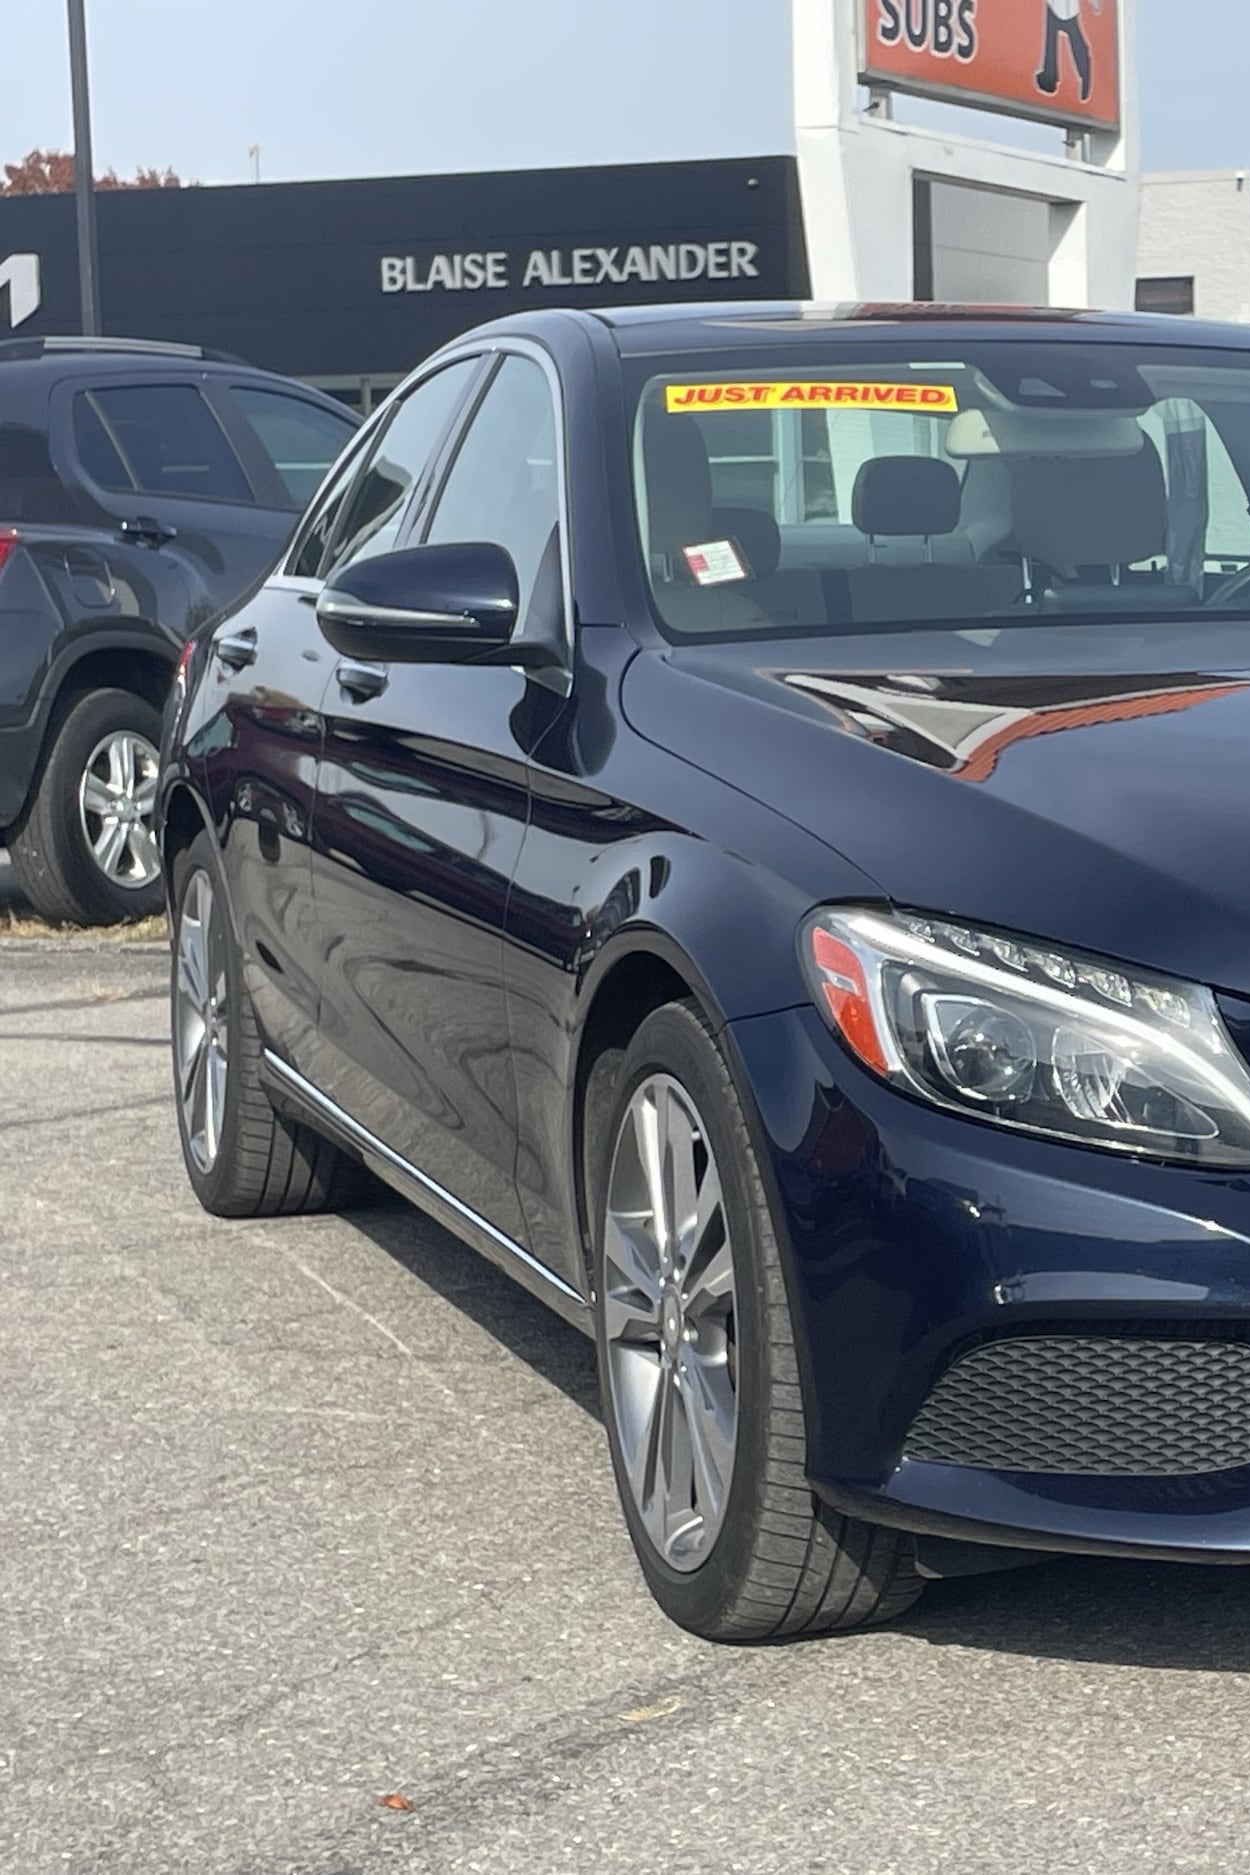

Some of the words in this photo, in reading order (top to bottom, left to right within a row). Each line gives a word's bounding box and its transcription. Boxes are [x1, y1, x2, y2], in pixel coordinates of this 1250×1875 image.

[878, 0, 976, 61] SUBS
[380, 252, 508, 292] BLAISE
[522, 241, 759, 287] ALEXANDER
[674, 387, 772, 405] JUST
[780, 386, 949, 404] ARRIVED
